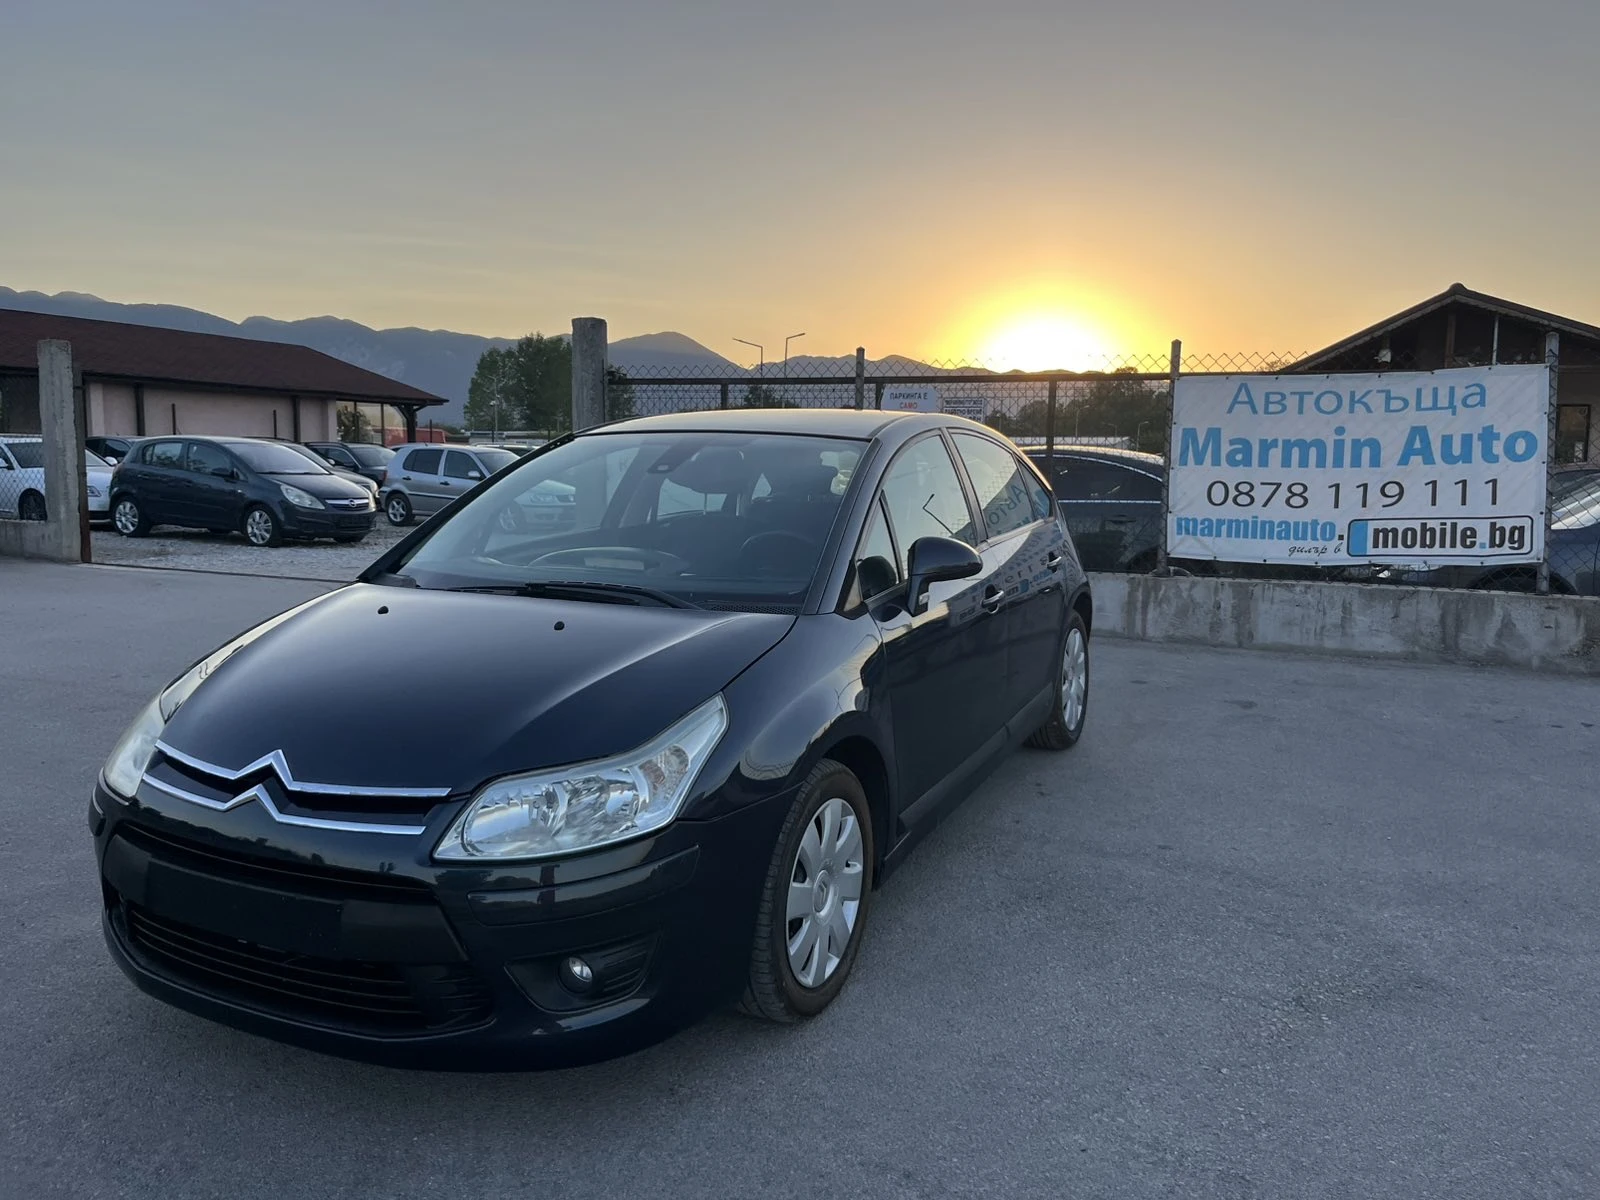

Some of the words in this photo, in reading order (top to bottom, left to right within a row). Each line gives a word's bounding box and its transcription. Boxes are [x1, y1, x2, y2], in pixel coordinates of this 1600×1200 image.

[889, 392, 922, 400] ПАРКИНГА
[1226, 382, 1486, 416] Автокъща
[1178, 425, 1382, 469] Marmin
[1396, 424, 1538, 466] Auto
[1206, 480, 1309, 509] 0878
[1327, 480, 1405, 509] 119
[1424, 478, 1498, 507] 111
[1372, 521, 1526, 551] mobile.bg
